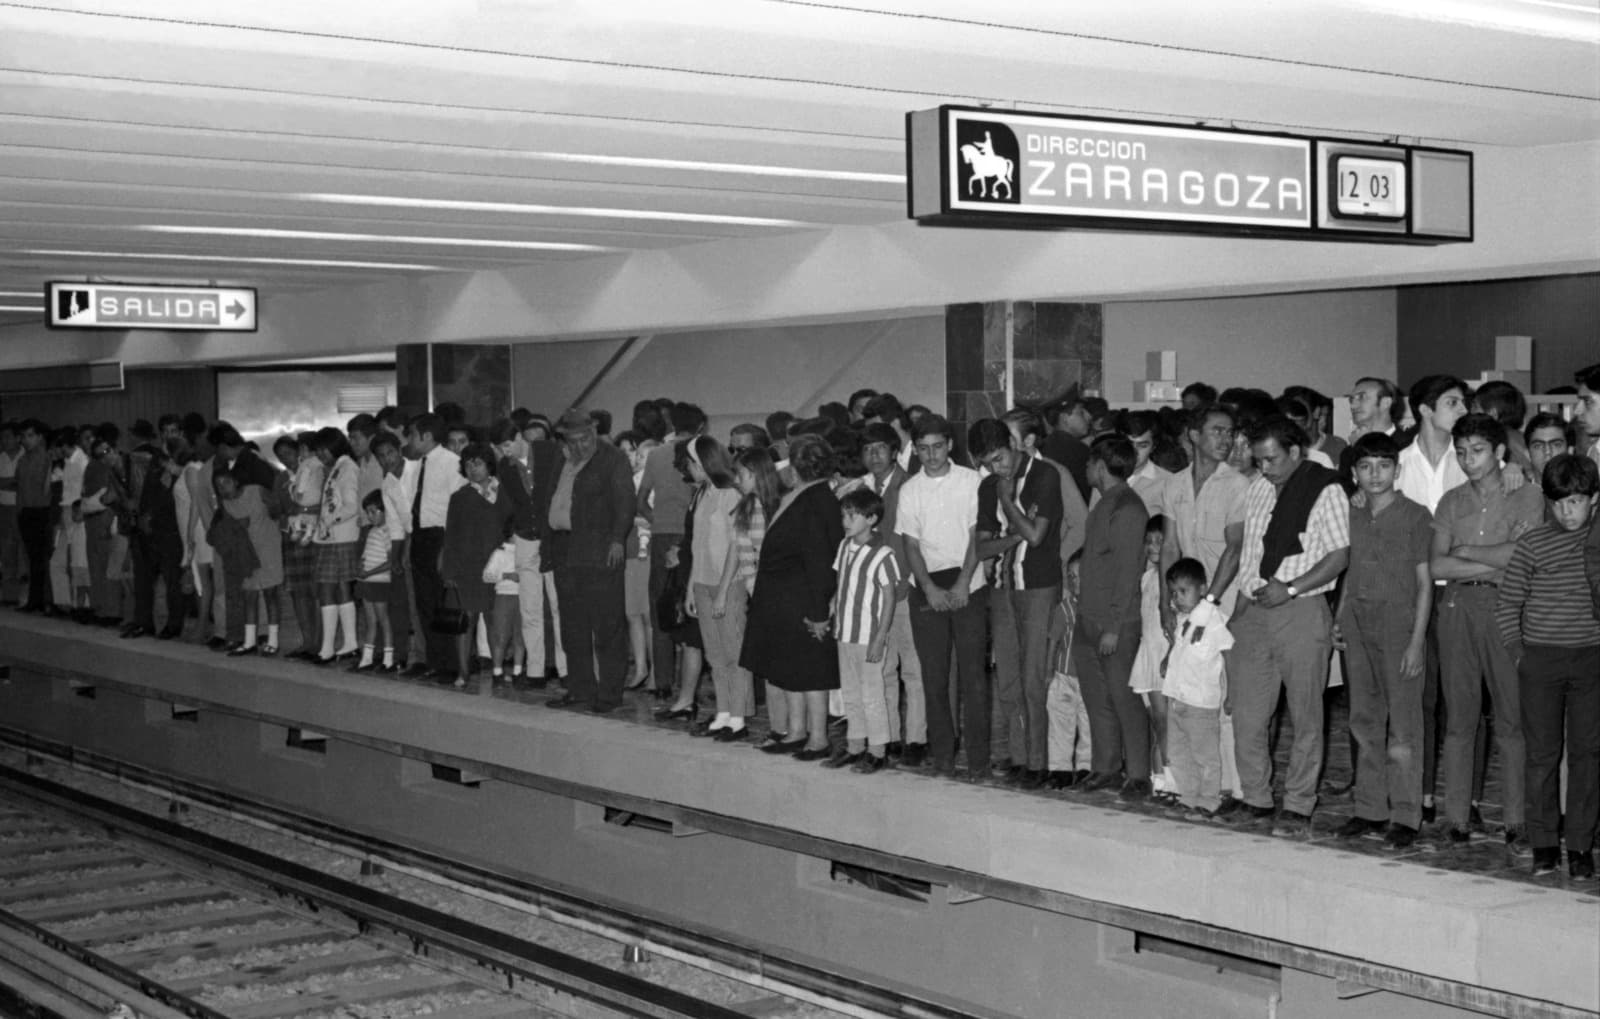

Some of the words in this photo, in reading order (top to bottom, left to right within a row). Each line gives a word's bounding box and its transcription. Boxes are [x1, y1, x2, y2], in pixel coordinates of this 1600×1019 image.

[1027, 134, 1146, 161] DIRECCION
[1028, 160, 1303, 211] ZARAGOZA
[100, 297, 216, 318] SALIDA
